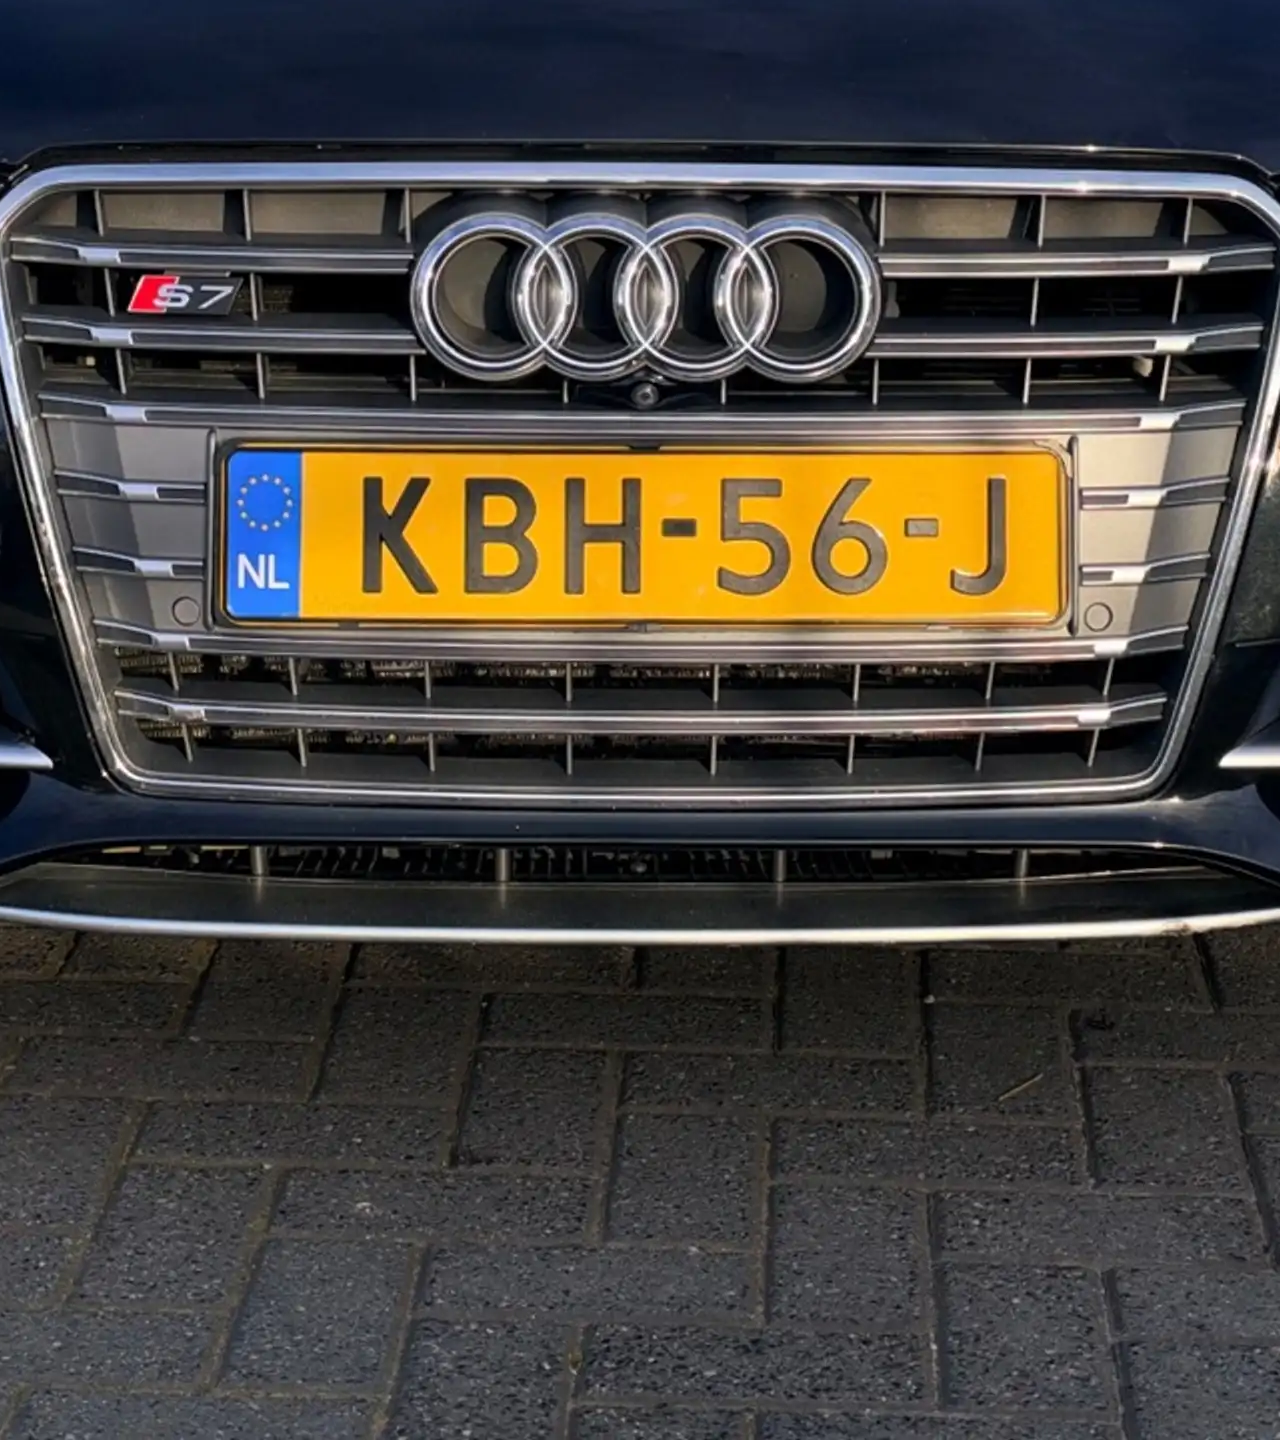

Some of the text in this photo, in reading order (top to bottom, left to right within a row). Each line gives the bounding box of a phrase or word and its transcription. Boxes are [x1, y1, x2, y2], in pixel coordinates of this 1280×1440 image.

[152, 283, 235, 309] S7
[362, 477, 1007, 595] KBH-56-J
[238, 553, 290, 589] NL
